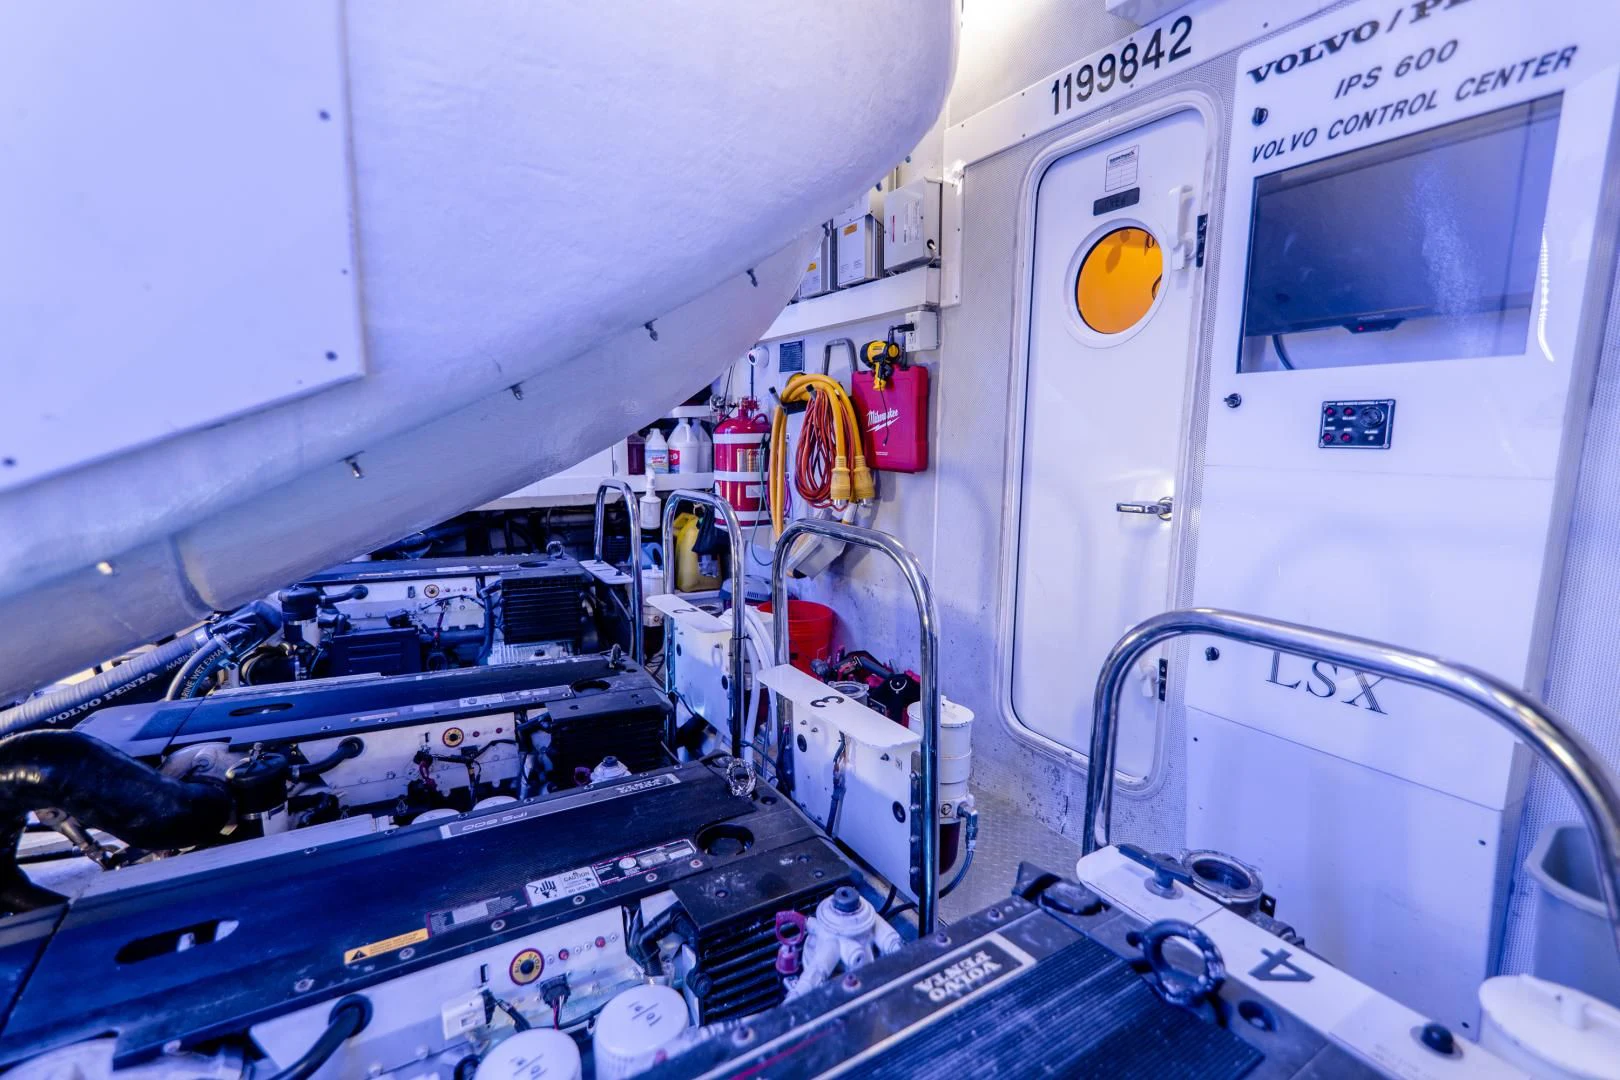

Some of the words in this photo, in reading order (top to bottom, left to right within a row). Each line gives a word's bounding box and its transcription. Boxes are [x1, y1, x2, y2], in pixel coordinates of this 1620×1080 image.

[1051, 15, 1193, 115] 1199842
[1334, 66, 1383, 99] IPS
[1394, 39, 1459, 78] 600
[1252, 127, 1318, 163] VOLVO
[1328, 89, 1439, 141] CONTROL
[1455, 45, 1579, 101] CENTER
[45, 698, 102, 724] VOLVO
[104, 672, 158, 700] PENTA
[810, 695, 845, 708] 3
[1266, 650, 1388, 715] LSX
[1248, 947, 1315, 982] 4
